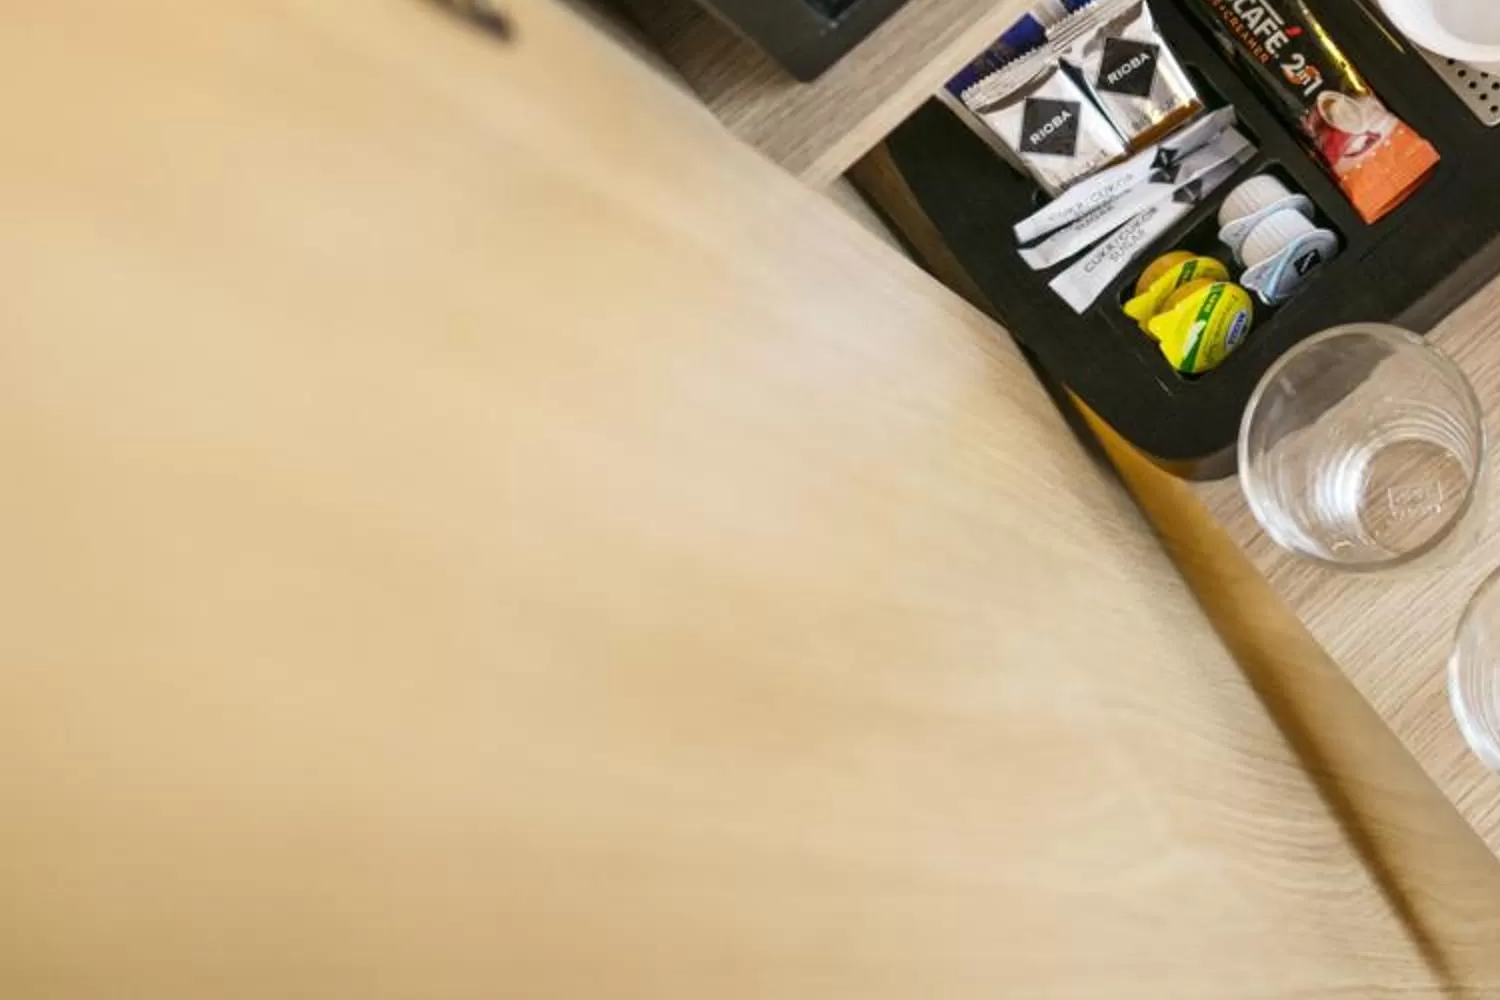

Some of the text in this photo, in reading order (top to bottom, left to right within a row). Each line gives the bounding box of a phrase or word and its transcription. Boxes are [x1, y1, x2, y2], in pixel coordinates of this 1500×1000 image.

[1107, 52, 1151, 84] RIOBA
[1281, 53, 1324, 96] 2in1
[1029, 109, 1073, 145] RIOBA
